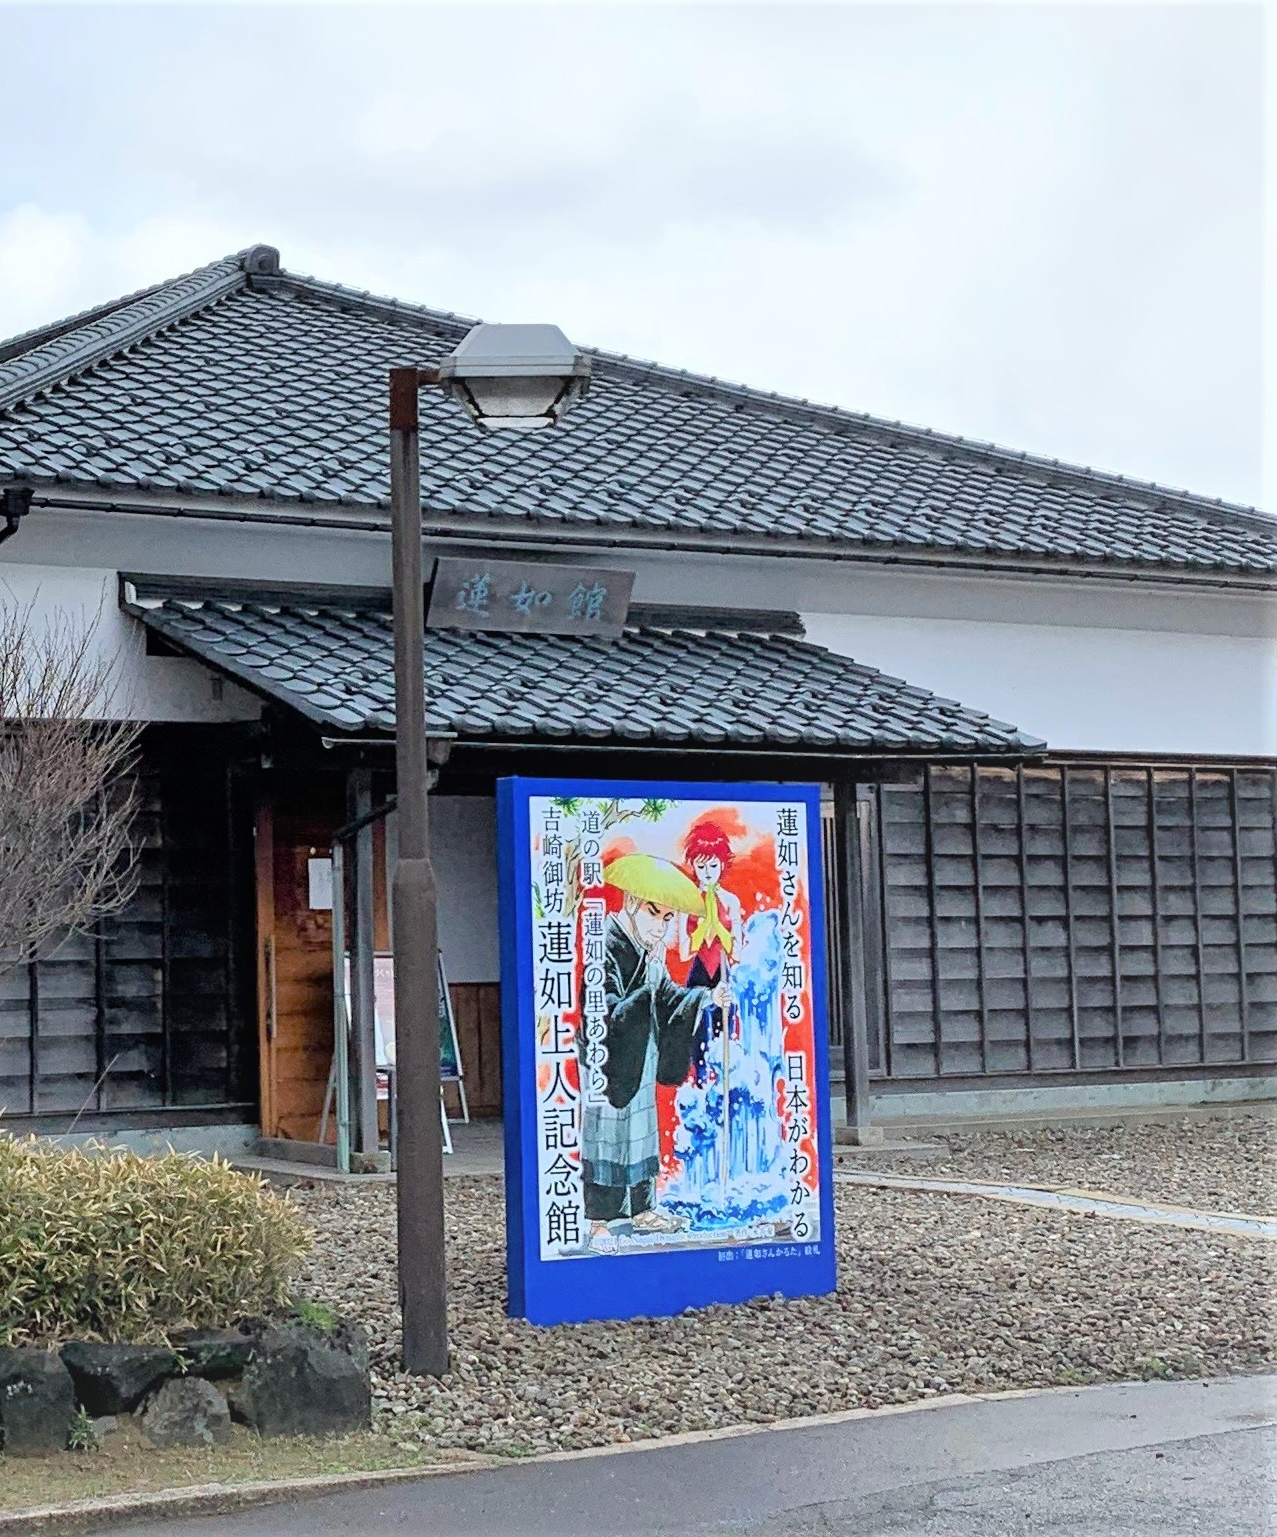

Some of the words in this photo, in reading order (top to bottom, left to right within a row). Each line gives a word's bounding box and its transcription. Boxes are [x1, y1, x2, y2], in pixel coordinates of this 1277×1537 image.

[776, 807, 803, 1020] 蓮如さんを知る
[538, 920, 581, 1246] 蓮如上人記念館
[785, 1055, 811, 1237] 日本がわかる
